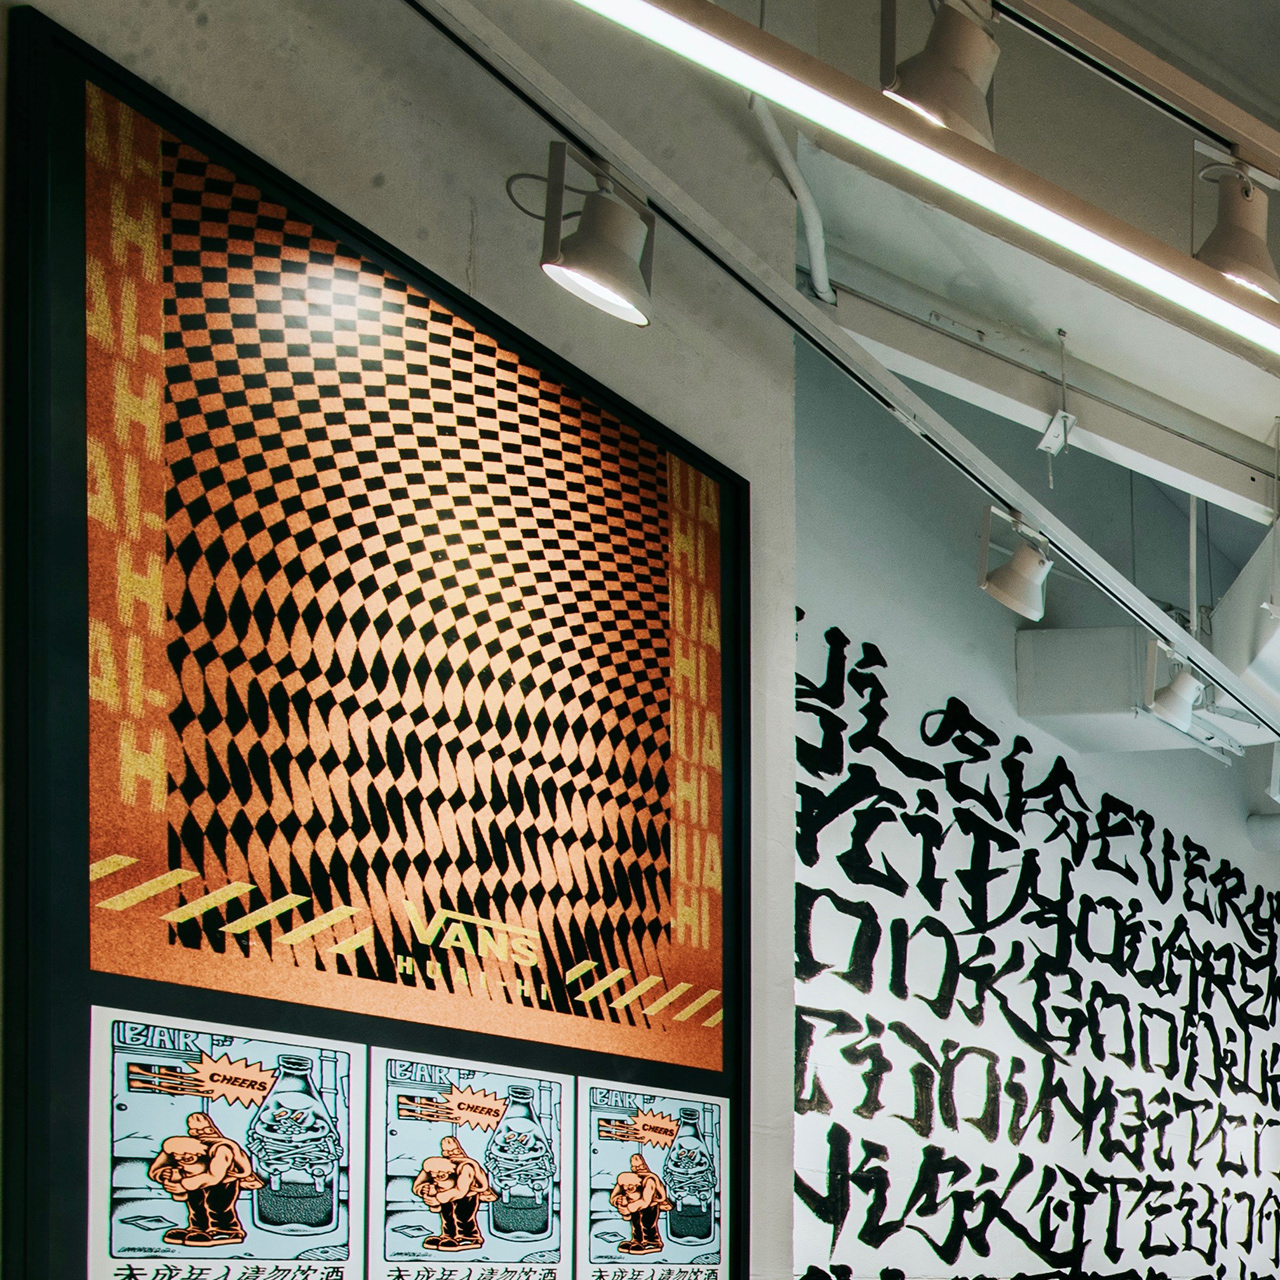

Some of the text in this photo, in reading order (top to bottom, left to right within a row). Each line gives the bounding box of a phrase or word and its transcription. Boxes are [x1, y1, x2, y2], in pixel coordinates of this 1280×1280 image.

[404, 901, 541, 967] VANS
[124, 1023, 202, 1053] BAR
[208, 1071, 268, 1093] CHEERS
[395, 1060, 451, 1085] BAR
[593, 1088, 638, 1108] BAR
[457, 1101, 501, 1118] CHEERS
[641, 1122, 675, 1139] CHEERS
